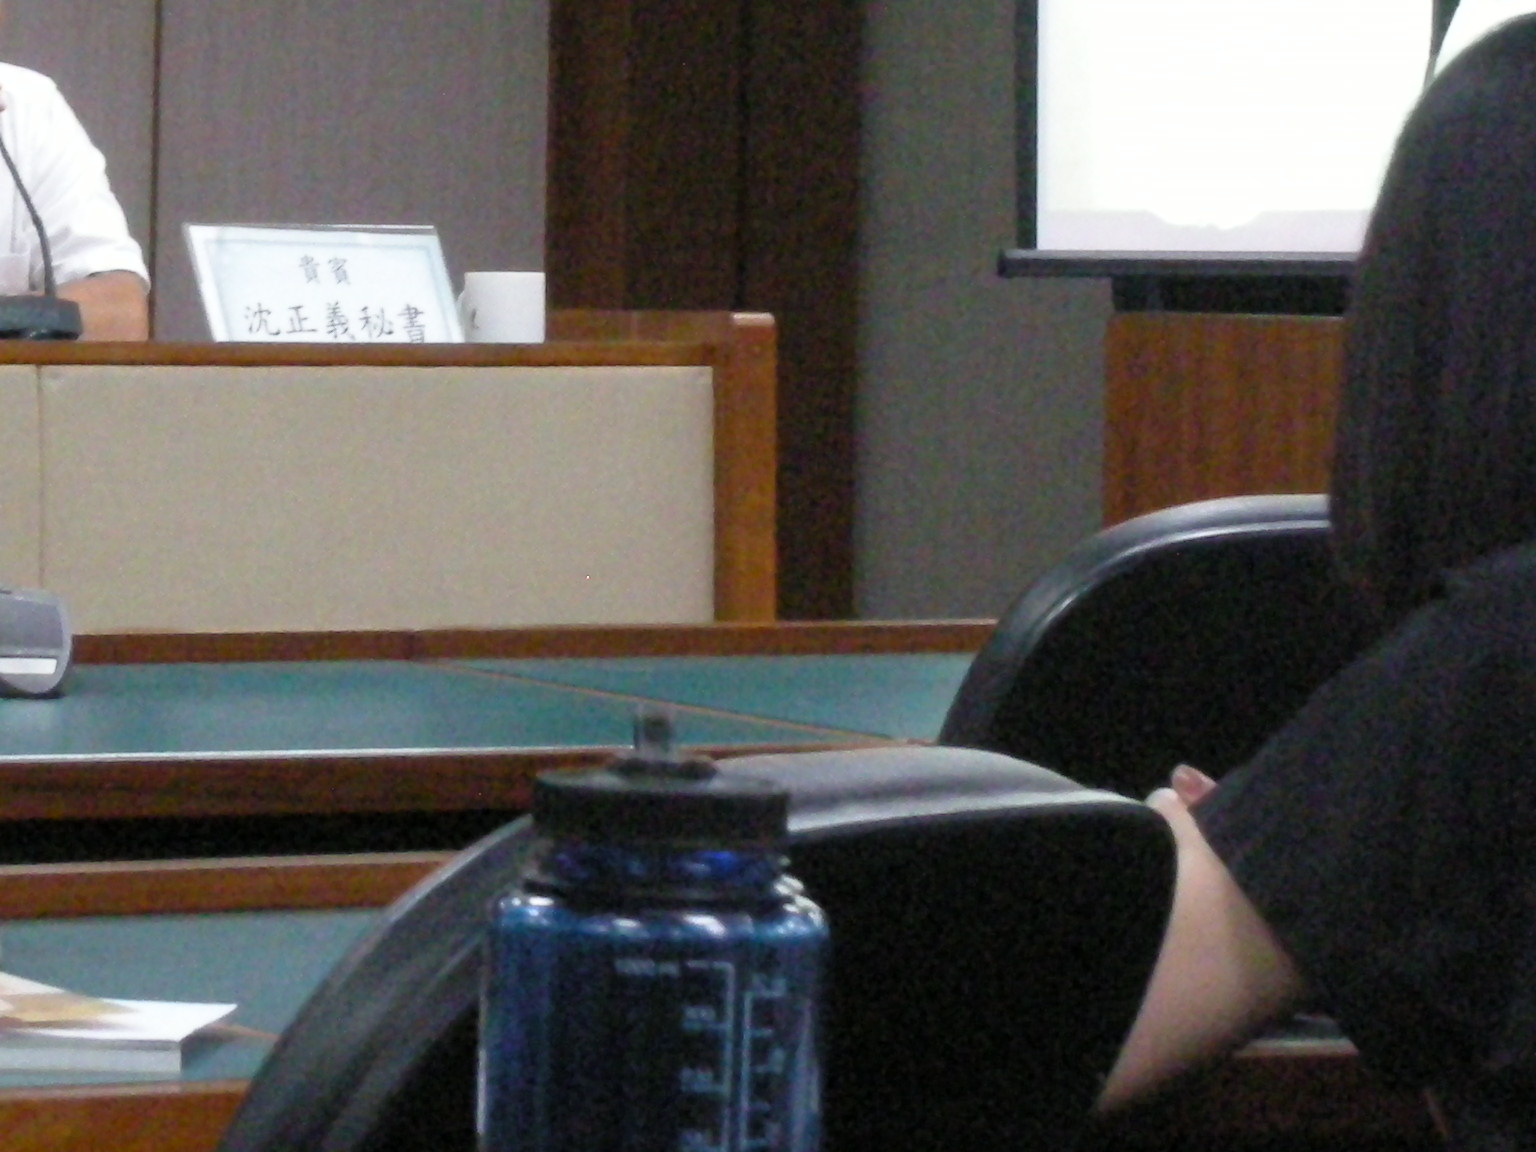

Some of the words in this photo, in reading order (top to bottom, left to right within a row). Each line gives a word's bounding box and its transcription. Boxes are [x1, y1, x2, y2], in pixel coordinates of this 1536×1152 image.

[243, 301, 426, 343] 沈正義秘書
